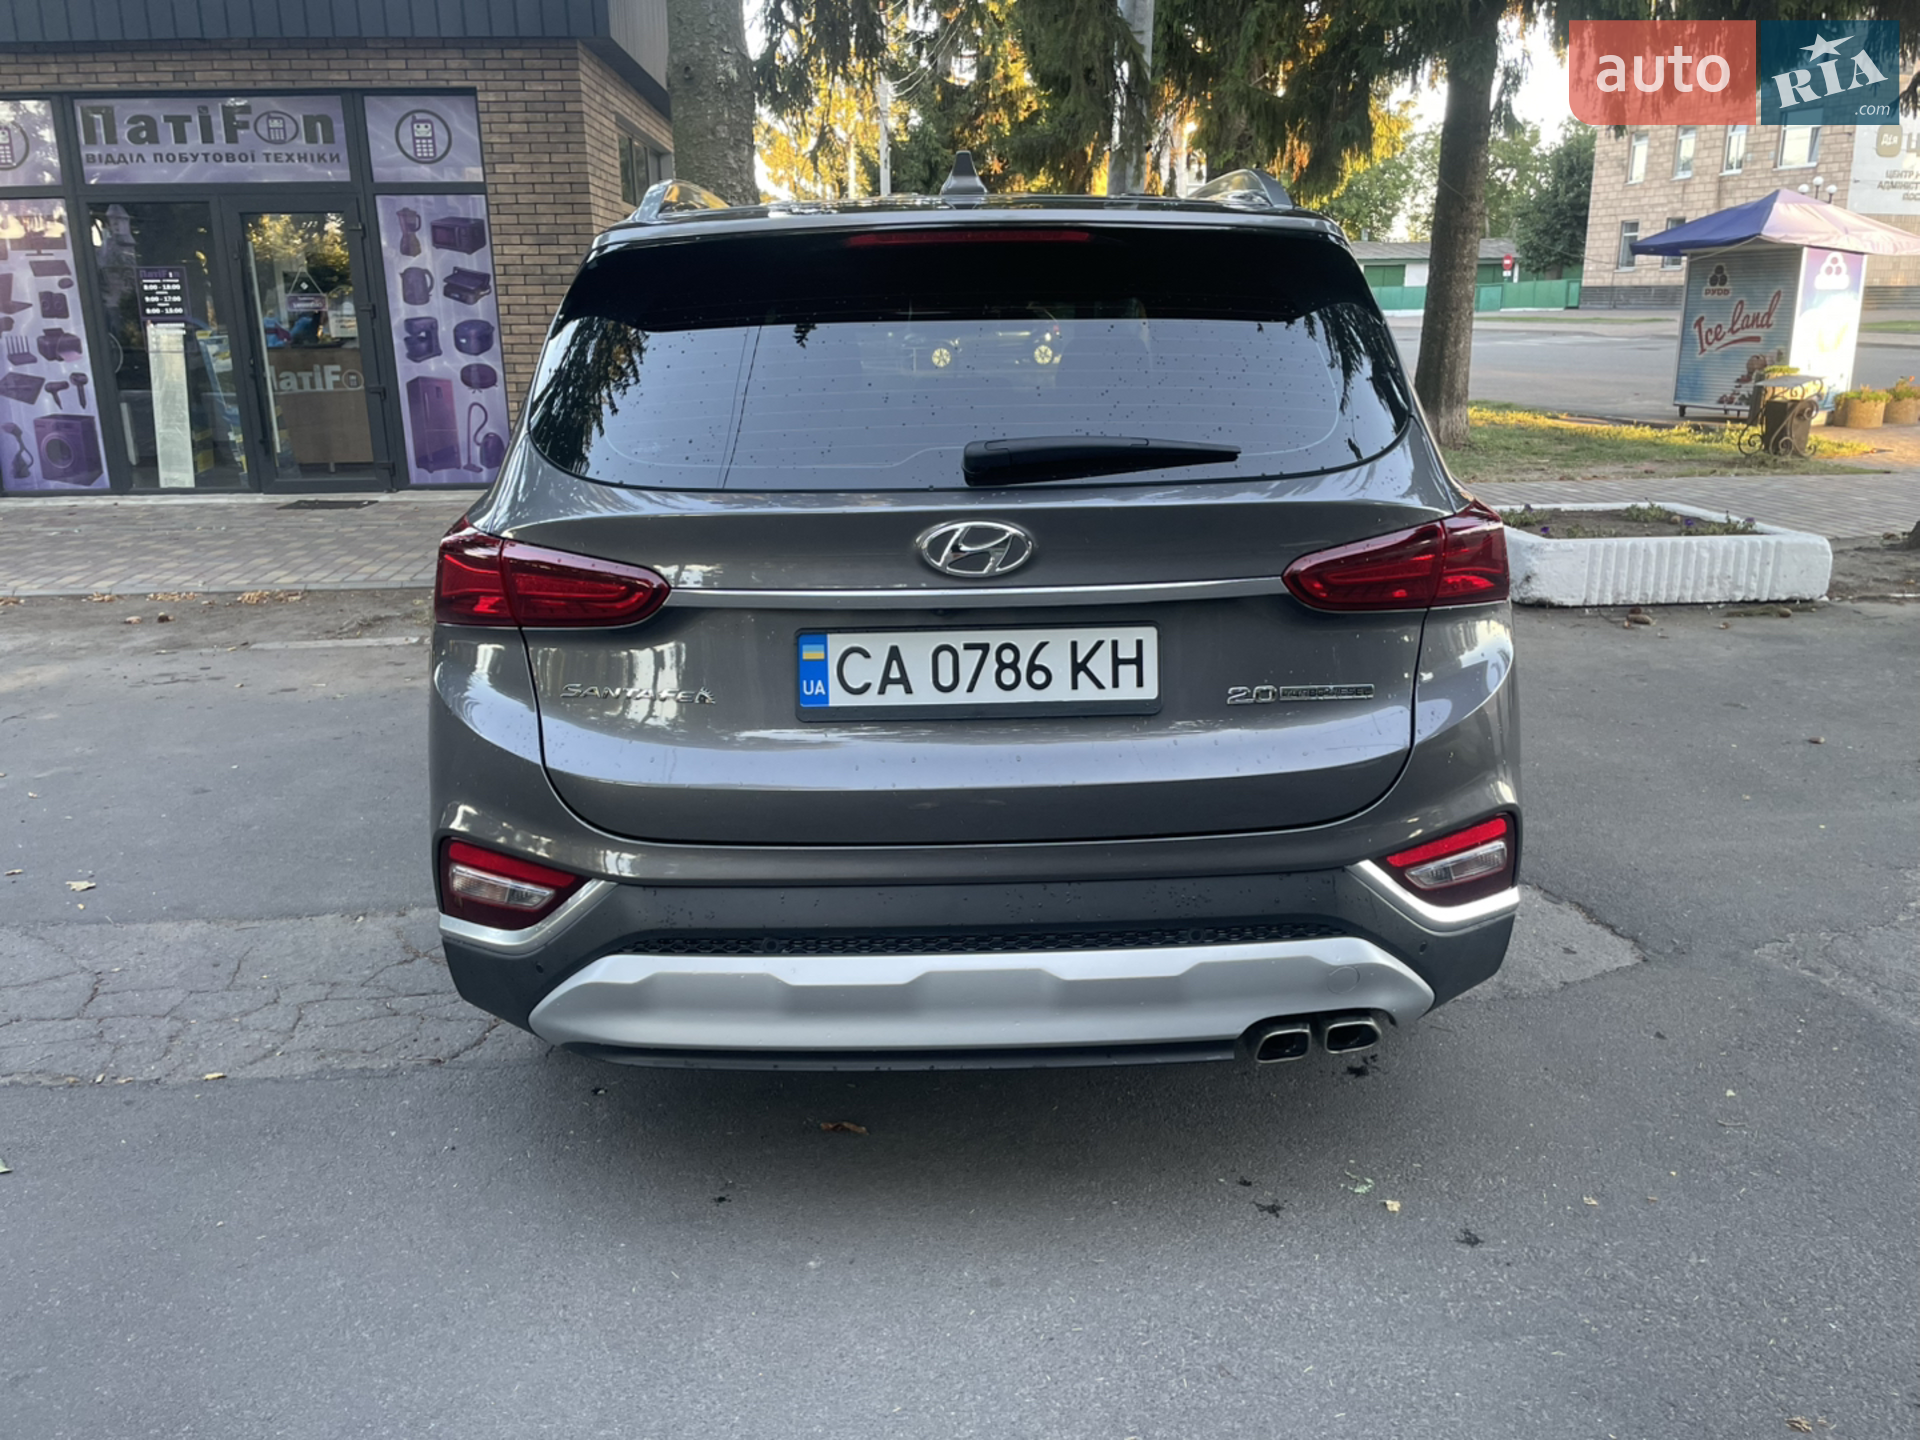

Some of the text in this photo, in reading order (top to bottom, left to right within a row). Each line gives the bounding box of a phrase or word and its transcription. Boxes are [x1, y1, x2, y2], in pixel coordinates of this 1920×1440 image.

[85, 150, 341, 165] ВІДДІЛ ПОБУТОВОЇ ТЕХНІКИ
[836, 639, 1144, 695] CA 0786 KH
[560, 684, 695, 703] SANTA FE
[803, 680, 826, 695] UA
